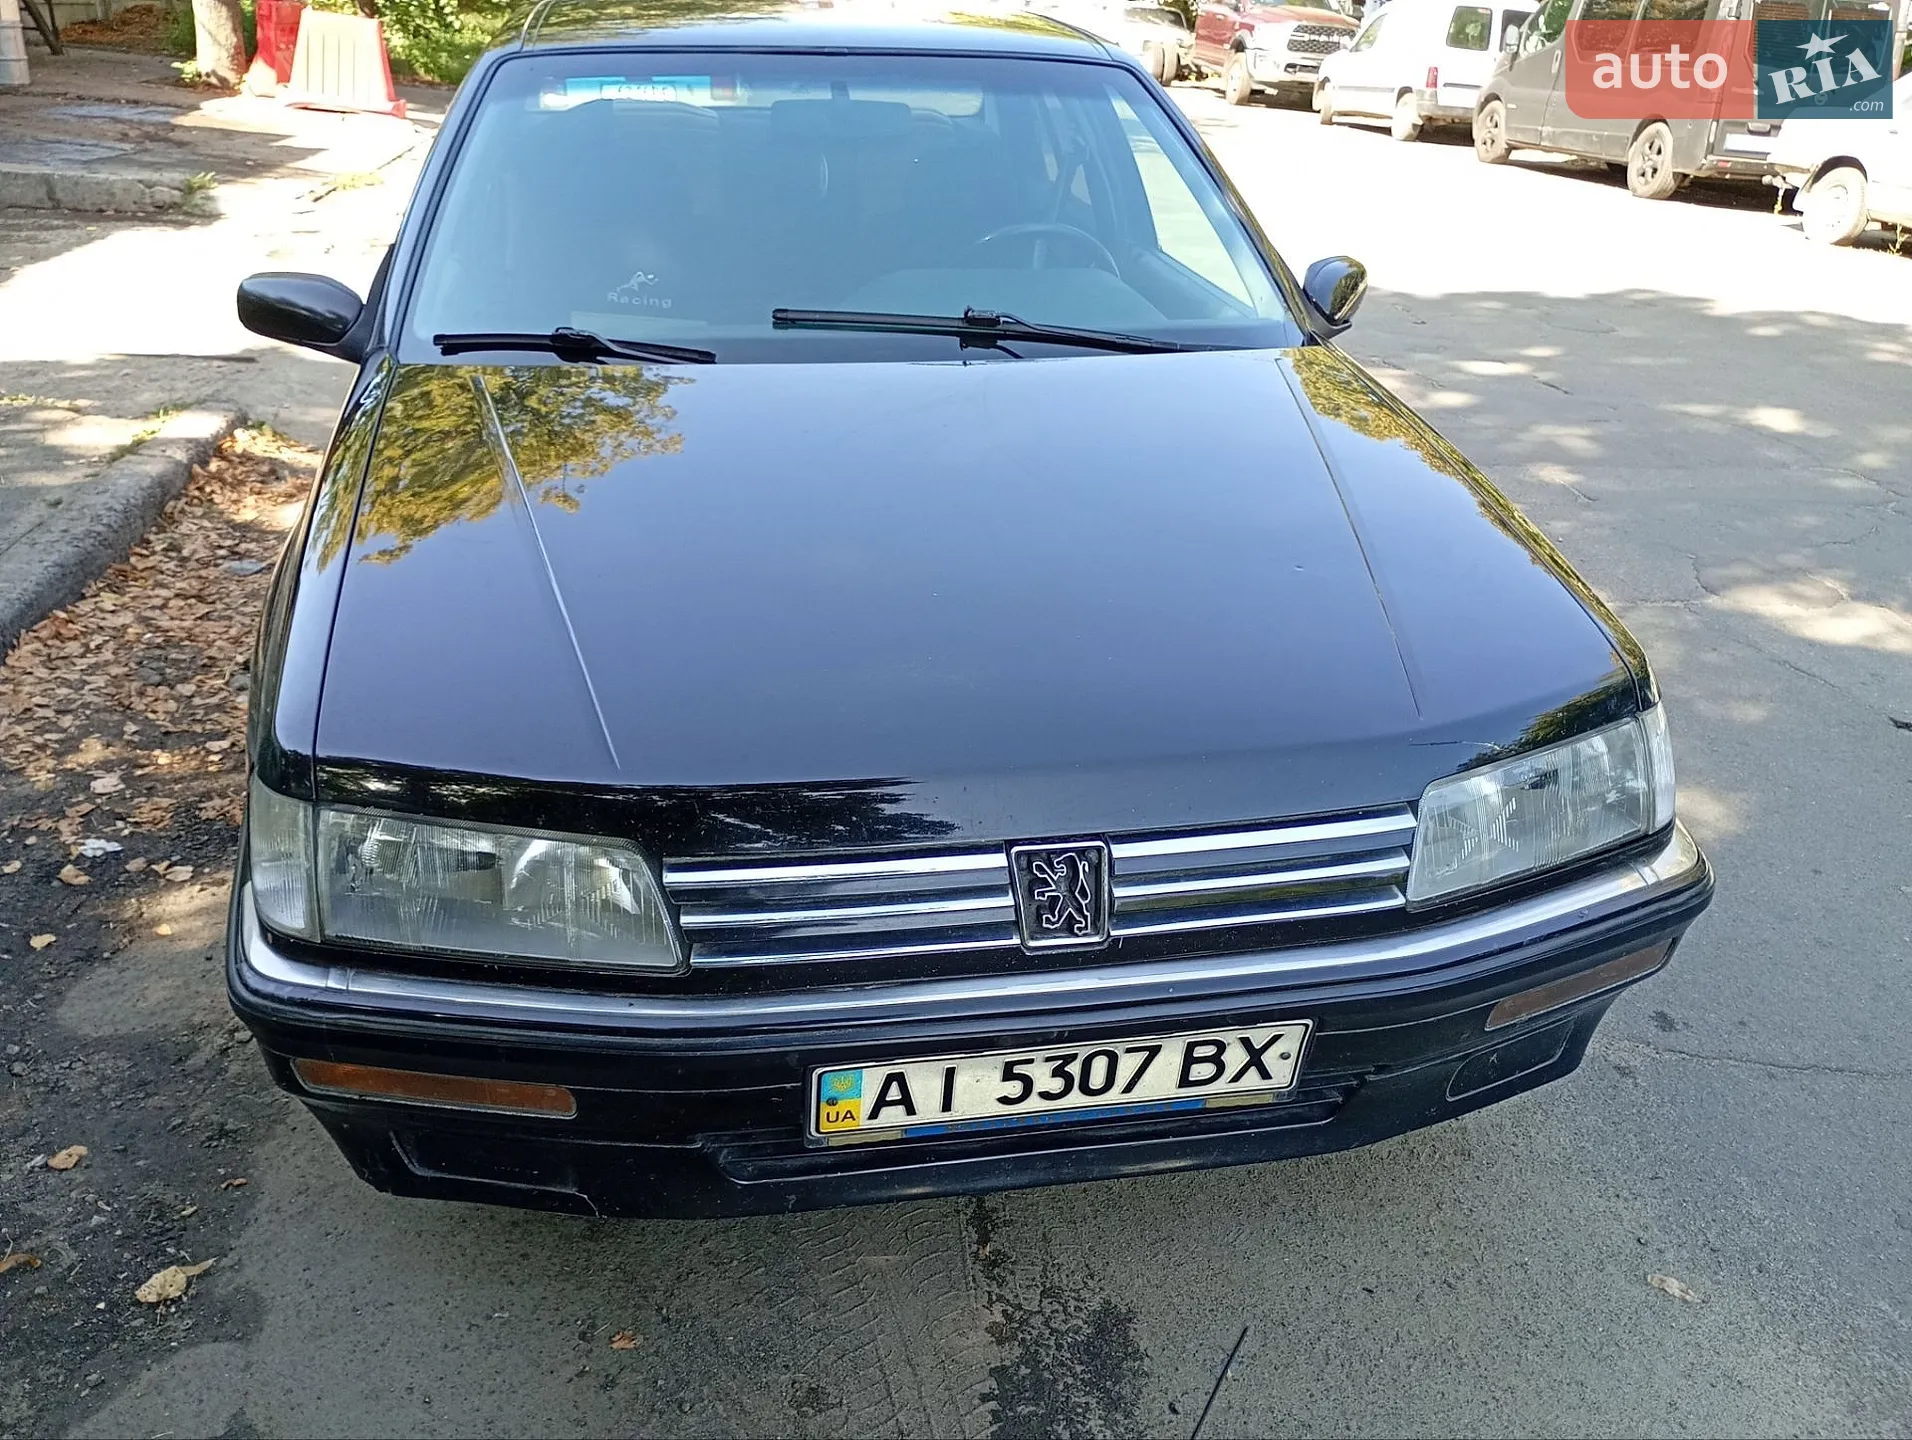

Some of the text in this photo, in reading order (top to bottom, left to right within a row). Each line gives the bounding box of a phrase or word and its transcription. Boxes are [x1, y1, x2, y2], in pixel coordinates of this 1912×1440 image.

[607, 292, 672, 309] Racing
[996, 1043, 1164, 1106] 5307
[1177, 1033, 1285, 1089] BX
[825, 1109, 856, 1125] UA
